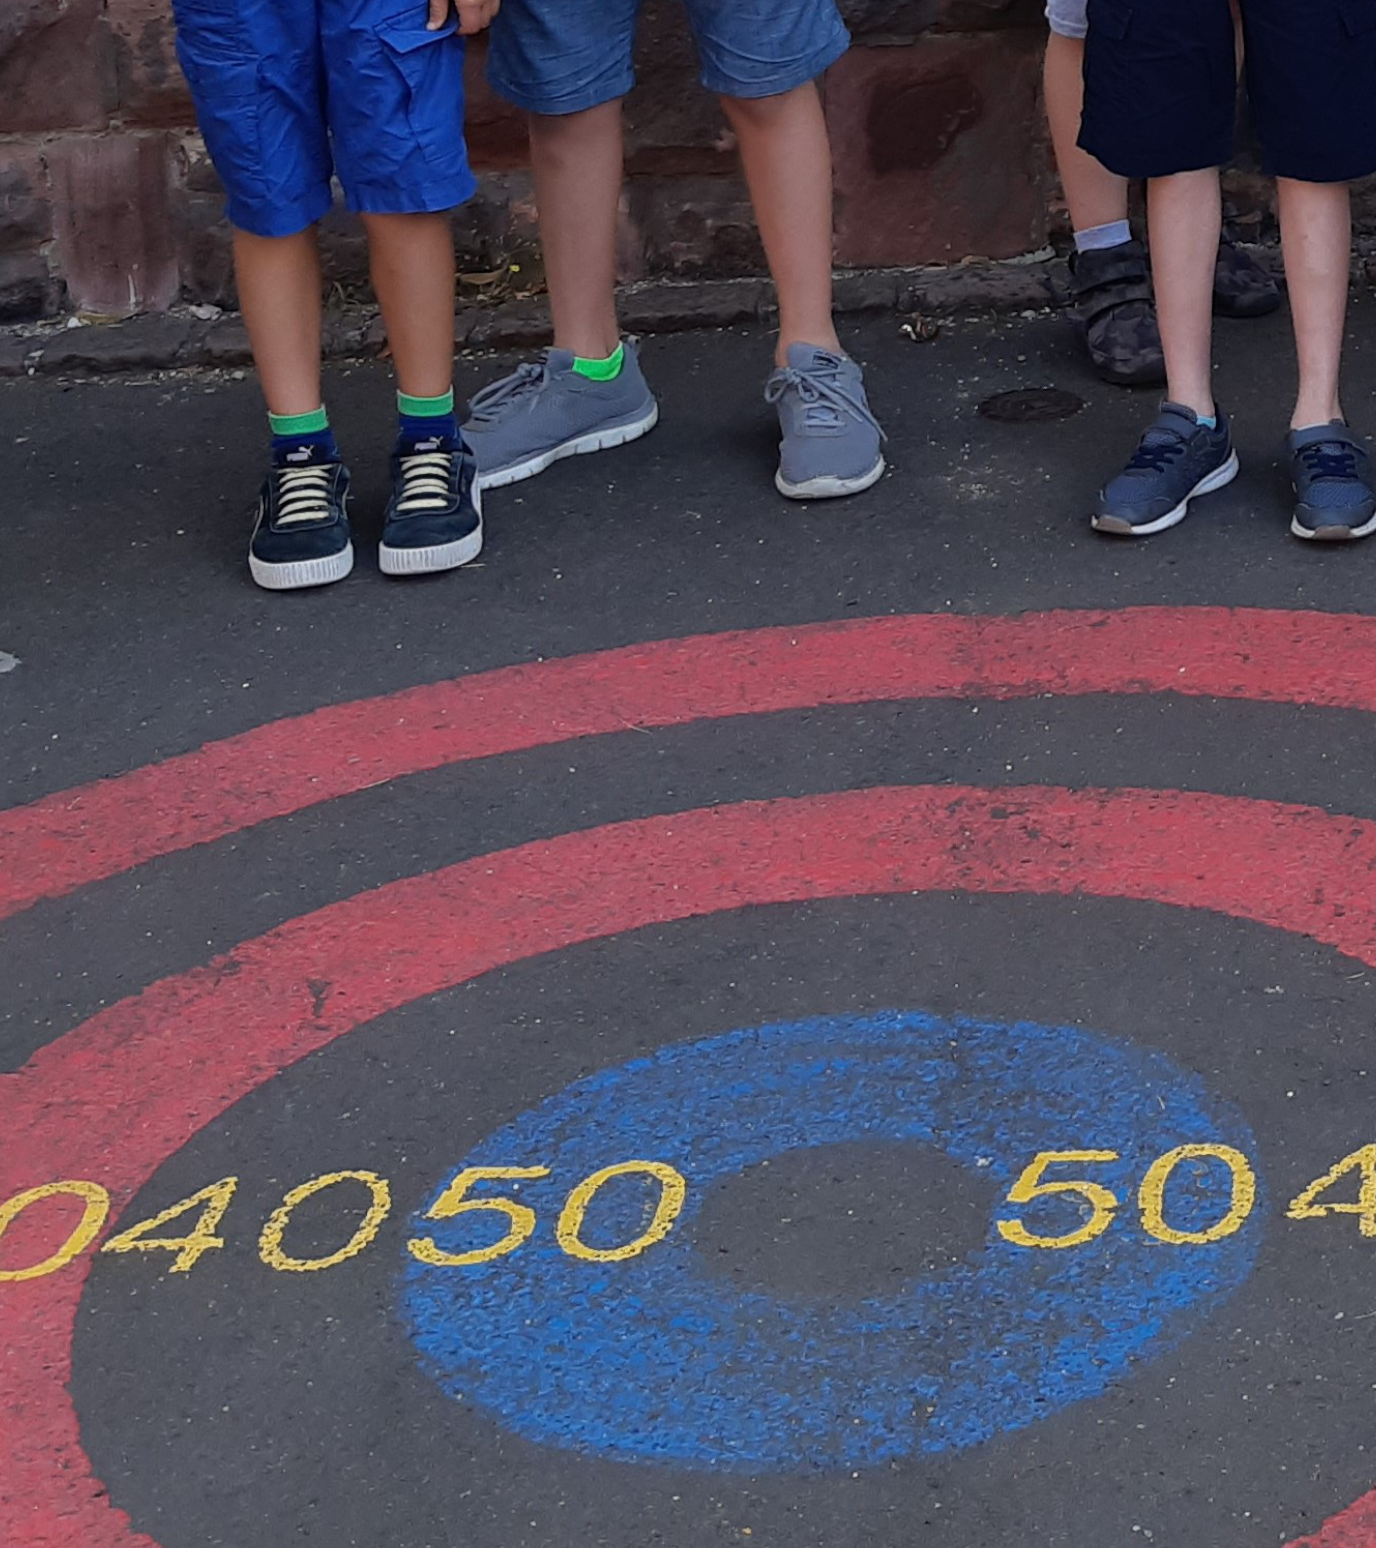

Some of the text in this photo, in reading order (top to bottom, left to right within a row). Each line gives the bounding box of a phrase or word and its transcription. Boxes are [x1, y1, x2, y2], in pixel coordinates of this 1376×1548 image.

[100, 1170, 391, 1272] 40
[408, 1162, 686, 1265] 50
[998, 1145, 1255, 1248] 50
